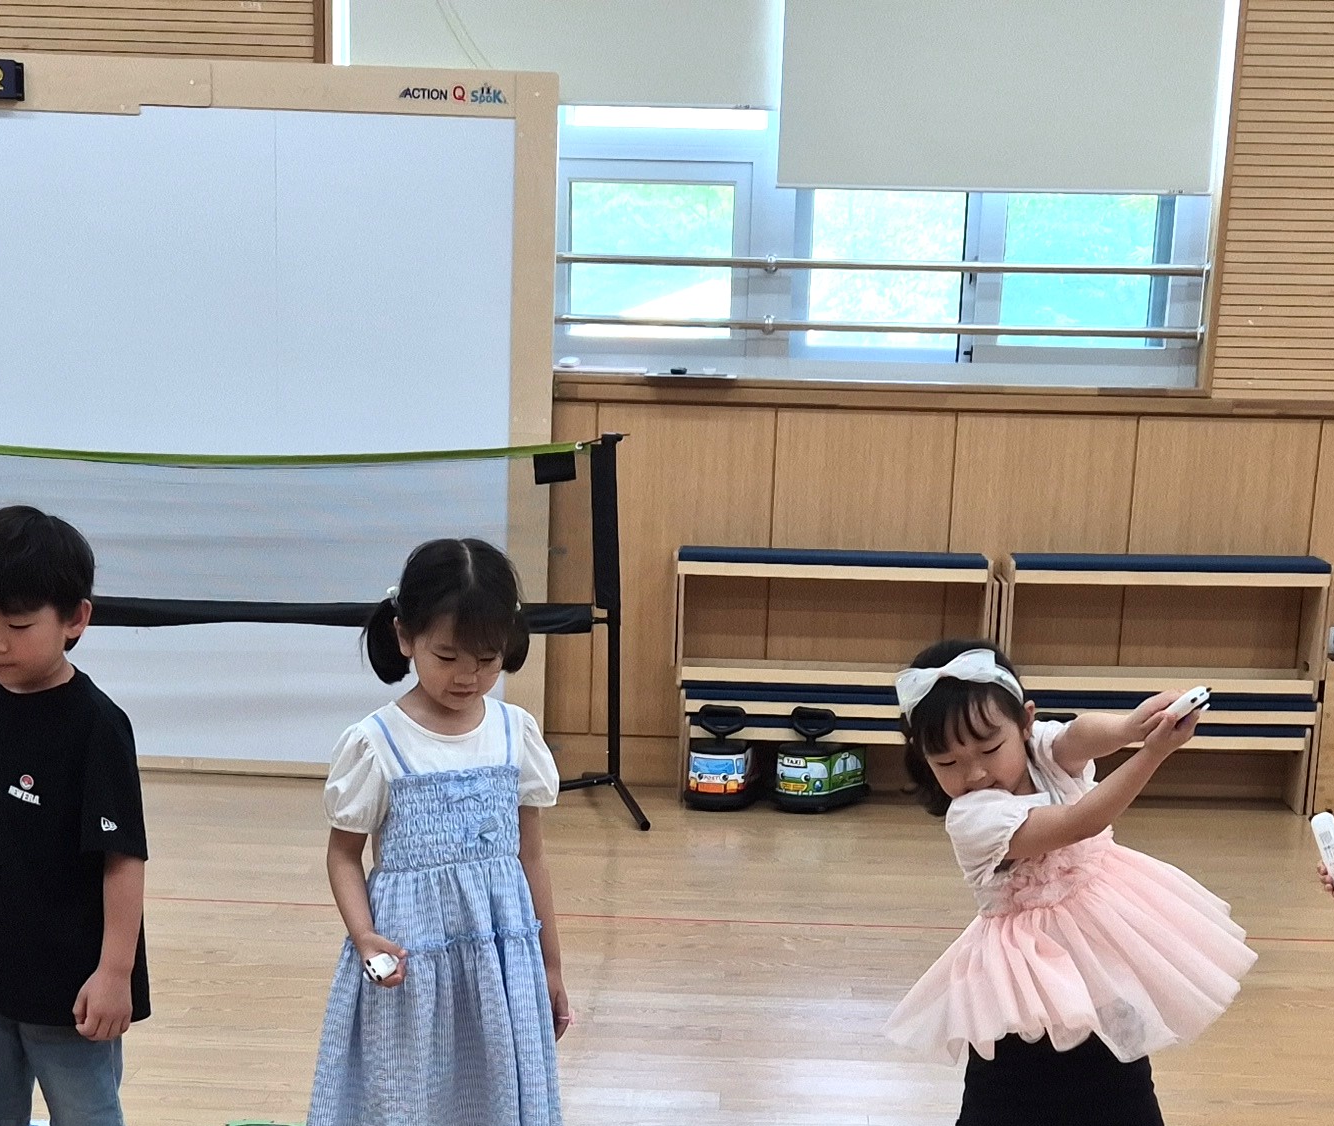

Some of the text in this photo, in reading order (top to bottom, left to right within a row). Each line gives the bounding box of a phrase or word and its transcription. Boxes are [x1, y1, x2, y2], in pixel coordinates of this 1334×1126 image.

[402, 86, 448, 101] ACTION
[452, 85, 466, 102] Q
[784, 757, 802, 766] TAXI
